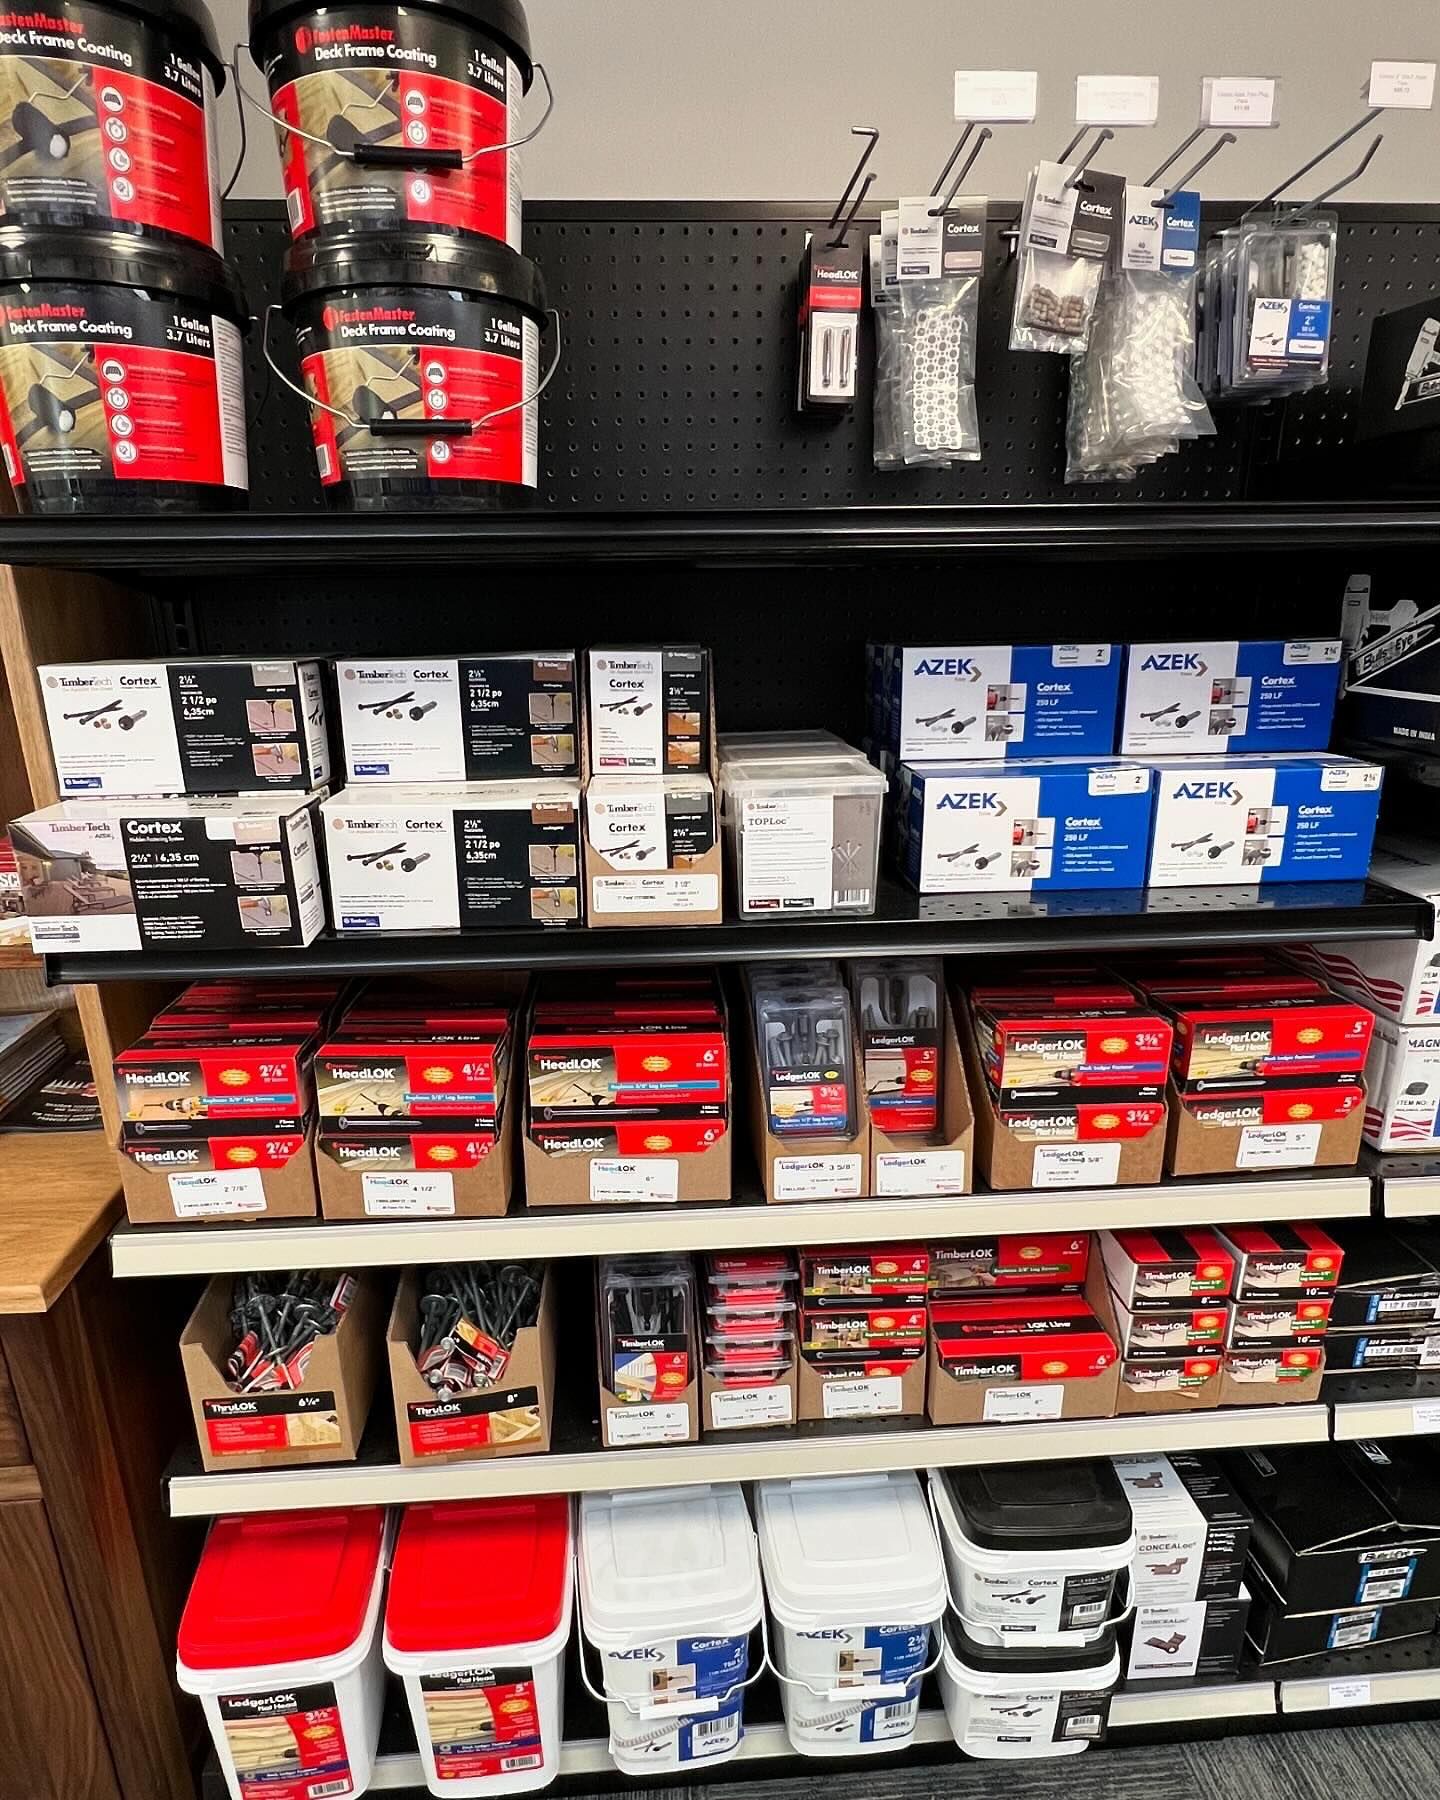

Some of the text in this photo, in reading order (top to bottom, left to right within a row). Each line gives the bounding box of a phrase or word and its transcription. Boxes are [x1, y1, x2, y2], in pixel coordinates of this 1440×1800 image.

[29, 31, 75, 49] Frame
[77, 38, 133, 67] Coating
[314, 44, 437, 67] Deck Frame Coating
[475, 49, 505, 75] 1 Gallon
[177, 57, 201, 80] Gallon
[164, 66, 201, 98] 3.7 Liters
[467, 65, 505, 92] 3.7 Liters
[1080, 200, 1113, 217] Cortex
[1129, 215, 1156, 227] AZEK
[1167, 217, 1194, 228] Cortex
[947, 223, 979, 234] Cortex
[817, 270, 858, 280] HeadLOK
[1258, 301, 1284, 311] AZEK
[337, 306, 416, 321] FastenMaster
[10, 320, 133, 338] Deck Frame Coating
[173, 316, 210, 334] 1 Gallon
[491, 318, 521, 336] 1 Gallon
[341, 323, 456, 341] Deck Frame Coating
[166, 330, 211, 348] 3.7 Liters
[484, 332, 521, 350] 3.7 Liters
[914, 658, 973, 676] AZEK
[1141, 653, 1199, 671] AZEK
[357, 670, 449, 680] TimberTech Cortex
[59, 675, 158, 687] TimberTech Cortex
[609, 679, 645, 689] Cortex
[1261, 676, 1296, 686] Cortex
[1037, 682, 1071, 692] Cortex
[469, 689, 502, 700] 2 1/2 po
[181, 697, 188, 705] 2
[190, 696, 204, 705] 1/2
[1173, 781, 1234, 799] AZEK
[936, 792, 998, 810] AZEK
[1298, 805, 1333, 815] Cortex
[127, 820, 183, 834] Cortex
[345, 819, 443, 830] TimberTech Cortex
[609, 822, 646, 832] Cortex
[1065, 816, 1101, 827] Cortex
[49, 823, 111, 832] TimberTech
[465, 840, 501, 852] 2 1/2 po
[160, 853, 182, 864] 6,35
[183, 853, 199, 863] cm
[1353, 1021, 1368, 1033] 5"
[871, 1035, 914, 1045] LedgerLOK
[1204, 1031, 1271, 1045] LedgerLOK
[1015, 1039, 1085, 1053] LedgerLOK
[1231, 1042, 1268, 1052] Flat Head
[704, 1050, 719, 1062] 6"
[1042, 1052, 1084, 1061] Flat Head
[541, 1058, 603, 1071] HeadLOK
[125, 1071, 191, 1084] HeadLOK
[332, 1067, 396, 1079] HeadLOK
[776, 1071, 820, 1082] LedgerLOK
[1343, 1096, 1357, 1107] 5"
[1197, 1107, 1261, 1120] LedgerLOK
[1008, 1116, 1076, 1128] LedgerLOK
[704, 1128, 719, 1141] 6"
[544, 1137, 605, 1150] HeadLOK
[135, 1149, 199, 1162] HeadLOK
[340, 1146, 401, 1158] HeadLOK
[883, 1157, 926, 1167] LedgerLOK
[177, 1176, 217, 1186] HeadLOK
[370, 1178, 409, 1186] HeadLOK
[1070, 1240, 1084, 1251] 6"
[935, 1249, 993, 1260] TimberLOK
[817, 1265, 870, 1275] TimberLOK
[911, 1259, 925, 1270] 4"
[1255, 1262, 1301, 1271] TimberLOK
[1145, 1271, 1192, 1280] TimberLOK
[1305, 1287, 1320, 1296] 10"
[908, 1313, 922, 1325] 4"
[1247, 1311, 1291, 1320] TimberLOK
[815, 1319, 867, 1330] TimberLOK
[1142, 1322, 1187, 1331] TimberLOK
[621, 1339, 665, 1348] TimberLOK
[1297, 1336, 1310, 1344] 10"
[1232, 1358, 1277, 1367] TimberLOK
[953, 1364, 1015, 1376] TimberLOK
[1135, 1369, 1179, 1378] TimberLOK
[506, 1393, 518, 1403] 8"
[212, 1401, 257, 1414] ThruLOK
[415, 1403, 461, 1416] ThruLOK
[691, 1638, 729, 1650] Cortex
[515, 1683, 529, 1693] 5"
[228, 1693, 295, 1708] LedgerLOK
[274, 1701, 298, 1711] Head
